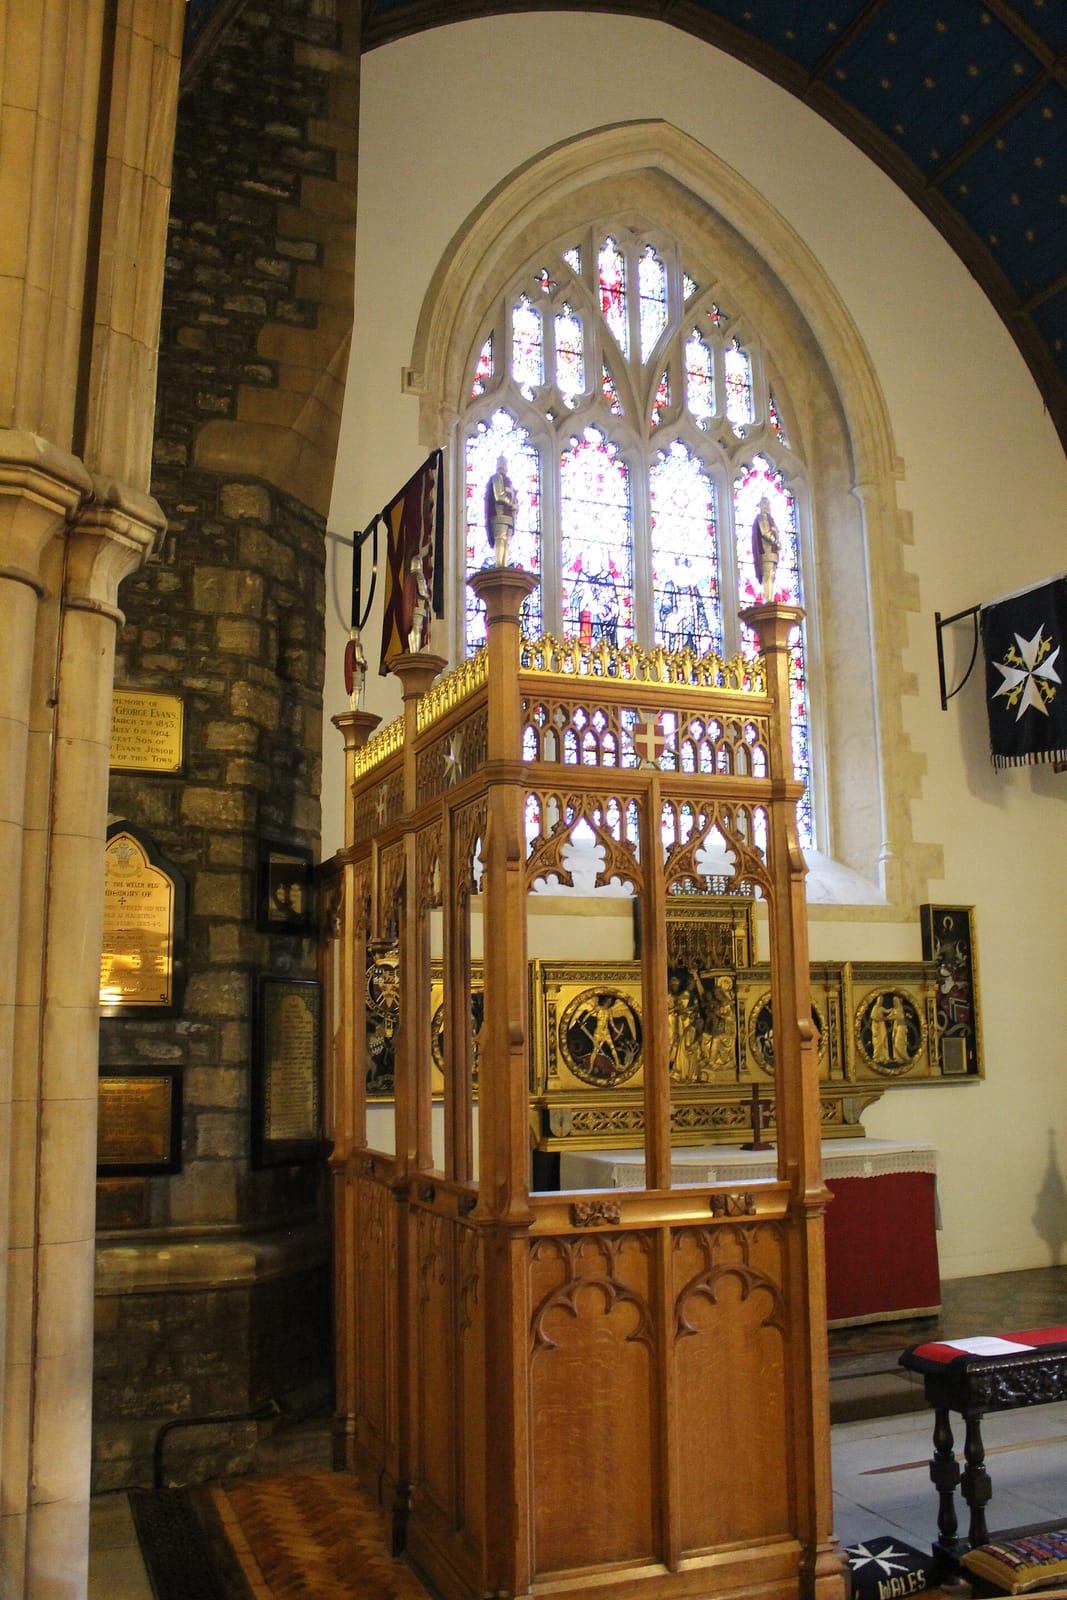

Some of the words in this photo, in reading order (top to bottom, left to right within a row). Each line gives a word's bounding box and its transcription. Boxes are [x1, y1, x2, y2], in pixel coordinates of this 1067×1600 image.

[115, 705, 148, 717] GEORGE
[145, 745, 174, 755] JUNIOR
[878, 1569, 926, 1600] WALES
